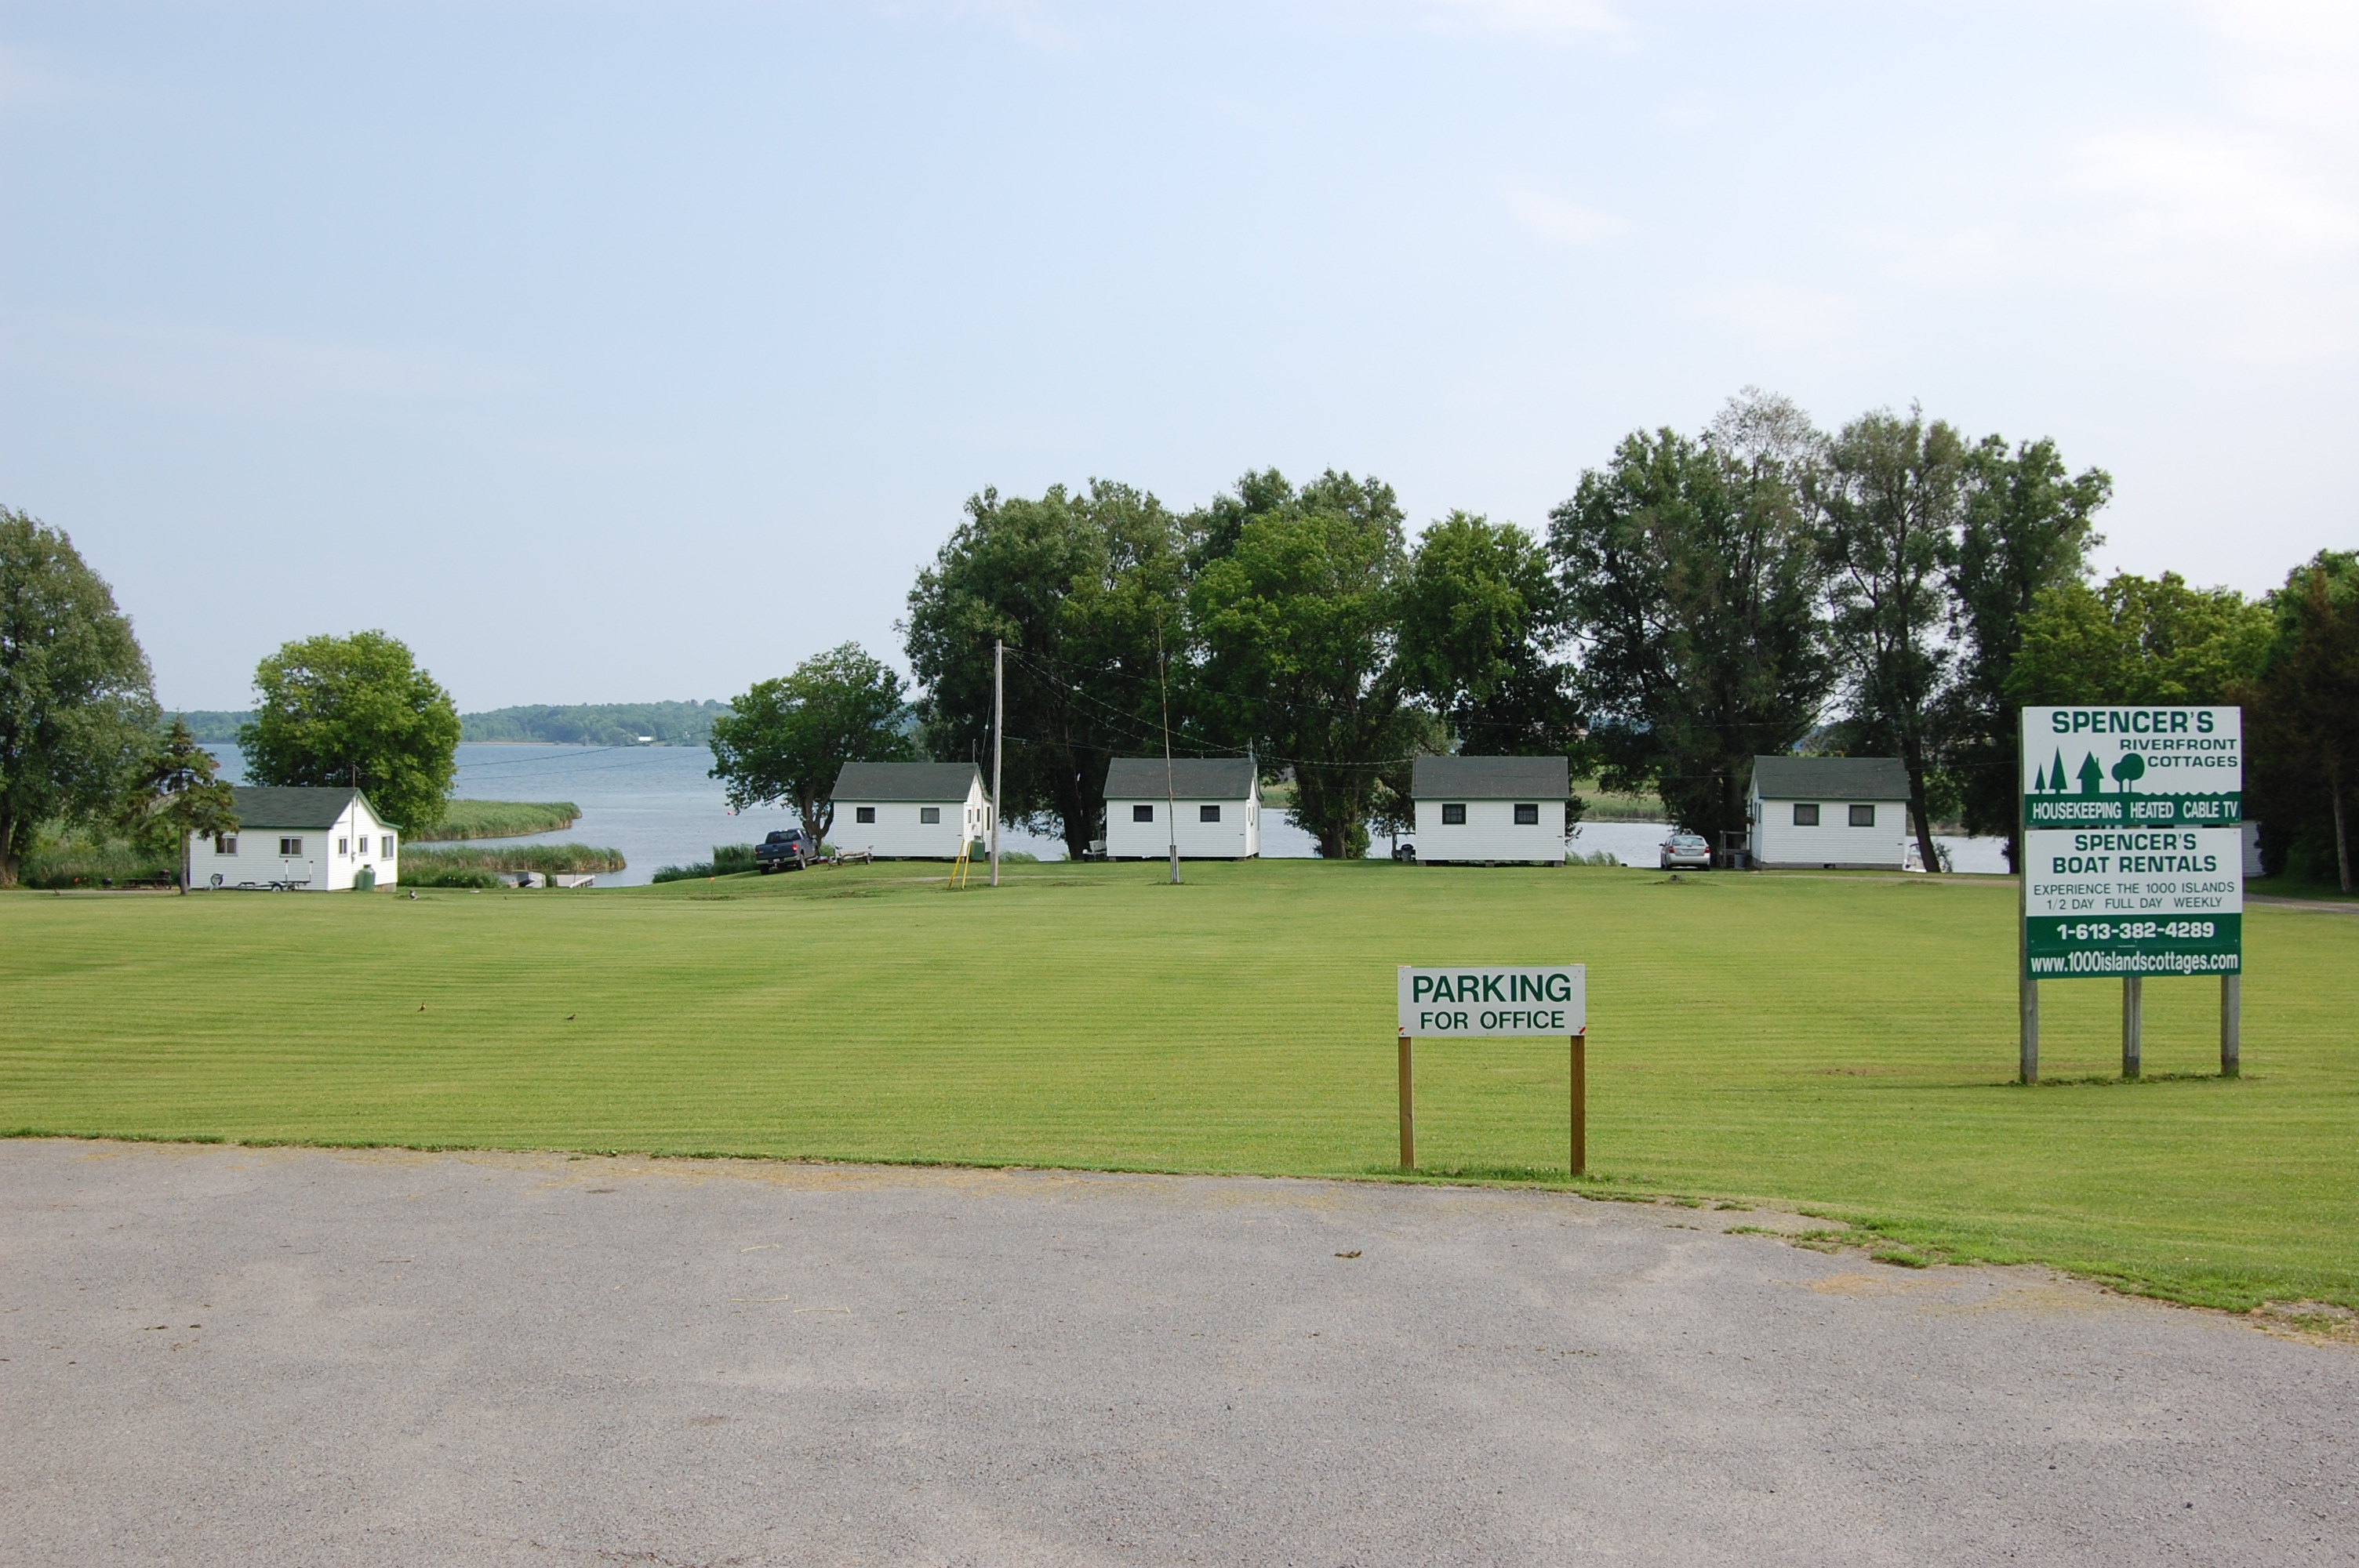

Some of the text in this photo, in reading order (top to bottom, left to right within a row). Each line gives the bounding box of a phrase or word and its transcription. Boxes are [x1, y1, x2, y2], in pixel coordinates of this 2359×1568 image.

[2052, 710, 2213, 734] SPENCER'S
[2120, 739, 2237, 750] RIVERFRONT
[2147, 756, 2238, 768] COTTAGES
[2033, 801, 2237, 819] HOUSEKEEPING HEATED CABLE TV
[2075, 833, 2196, 851] SPENCER'S
[2053, 855, 2216, 873] BOAT RENTALS
[2034, 882, 2235, 895] EXPERIENCE THE 1000 ISLANDS
[2047, 897, 2223, 911] 1/2 DAY FULL DAY WEEKLY
[2056, 922, 2215, 940] 1-613-382-4289
[2031, 950, 2238, 975] www.1000islandscottages.com
[1413, 974, 1571, 1003] PARKING
[1421, 1011, 1565, 1029] FOR OFFICE
